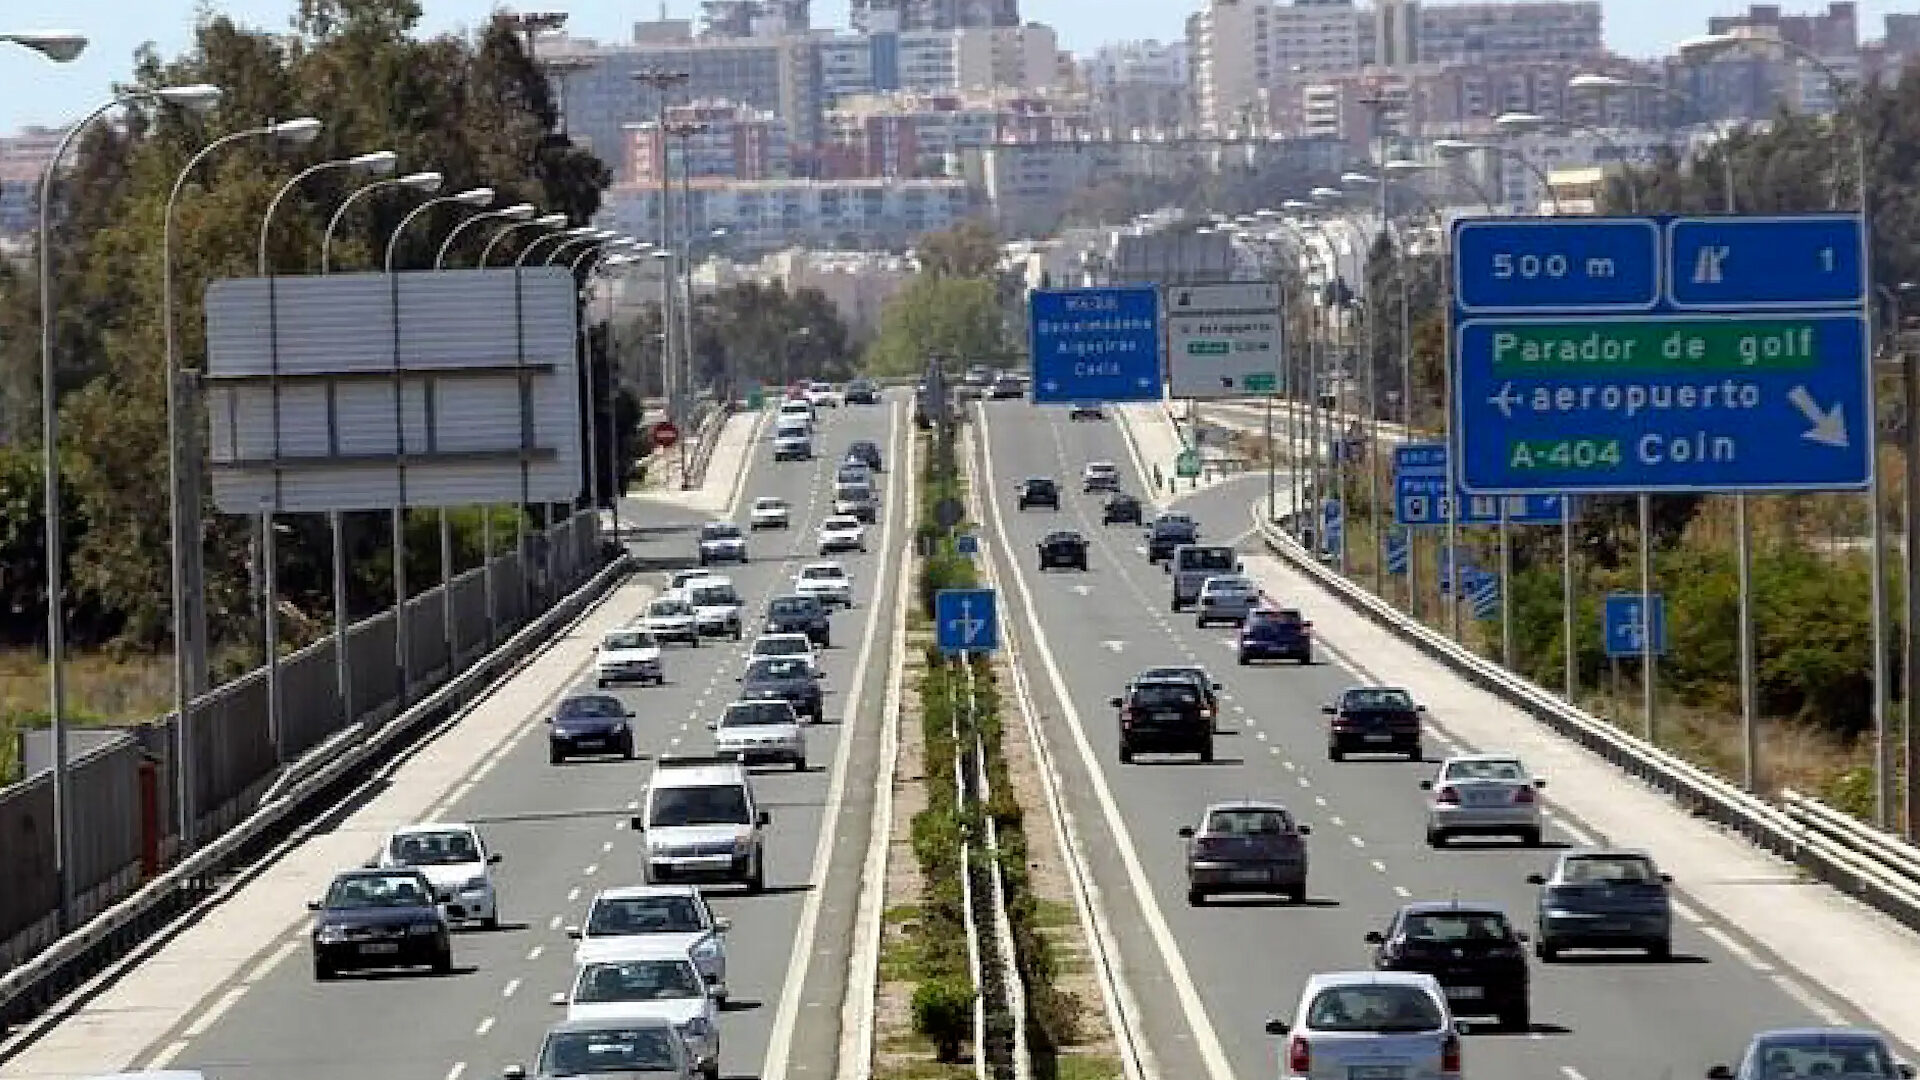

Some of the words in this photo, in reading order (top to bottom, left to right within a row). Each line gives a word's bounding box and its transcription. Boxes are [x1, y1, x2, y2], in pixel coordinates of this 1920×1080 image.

[1491, 253, 1568, 278] 500
[1585, 256, 1615, 278] m
[1818, 246, 1835, 272] 1
[1492, 332, 1637, 362] Parador
[1662, 330, 1706, 358] de
[1739, 327, 1814, 365] golf
[1531, 379, 1760, 416] aeropuerto
[1510, 440, 1621, 469] A-404
